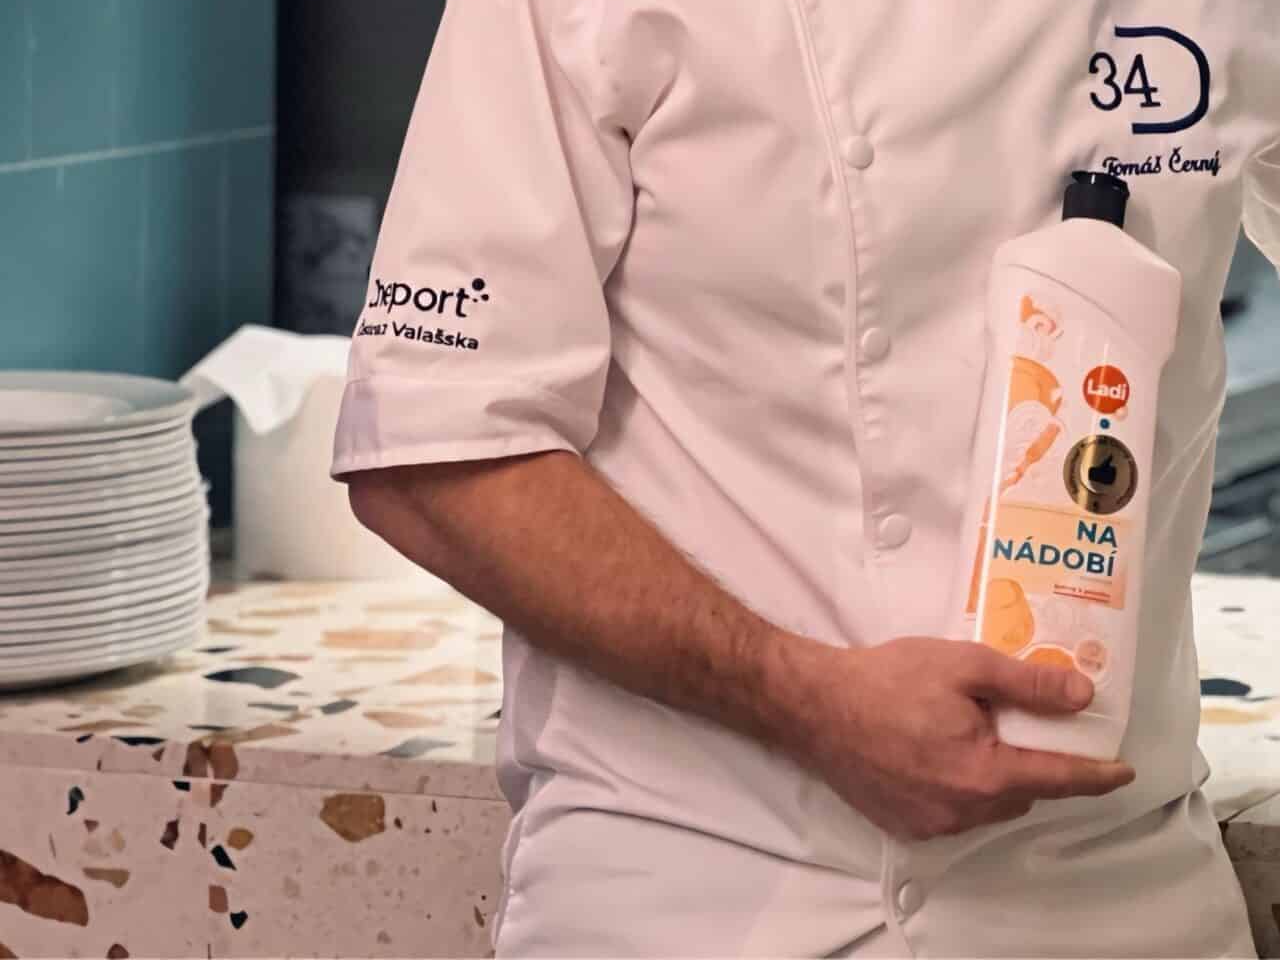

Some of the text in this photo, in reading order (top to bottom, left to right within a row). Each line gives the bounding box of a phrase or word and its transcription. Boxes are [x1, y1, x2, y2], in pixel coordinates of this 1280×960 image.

[1088, 51, 1161, 111] 34
[1102, 146, 1222, 177] Tomáš Černý
[369, 278, 469, 317] heport
[391, 320, 480, 351] Valašska
[1087, 377, 1128, 401] Ladi
[1076, 519, 1118, 548] NA
[992, 536, 1118, 577] NÁDOBÍ
